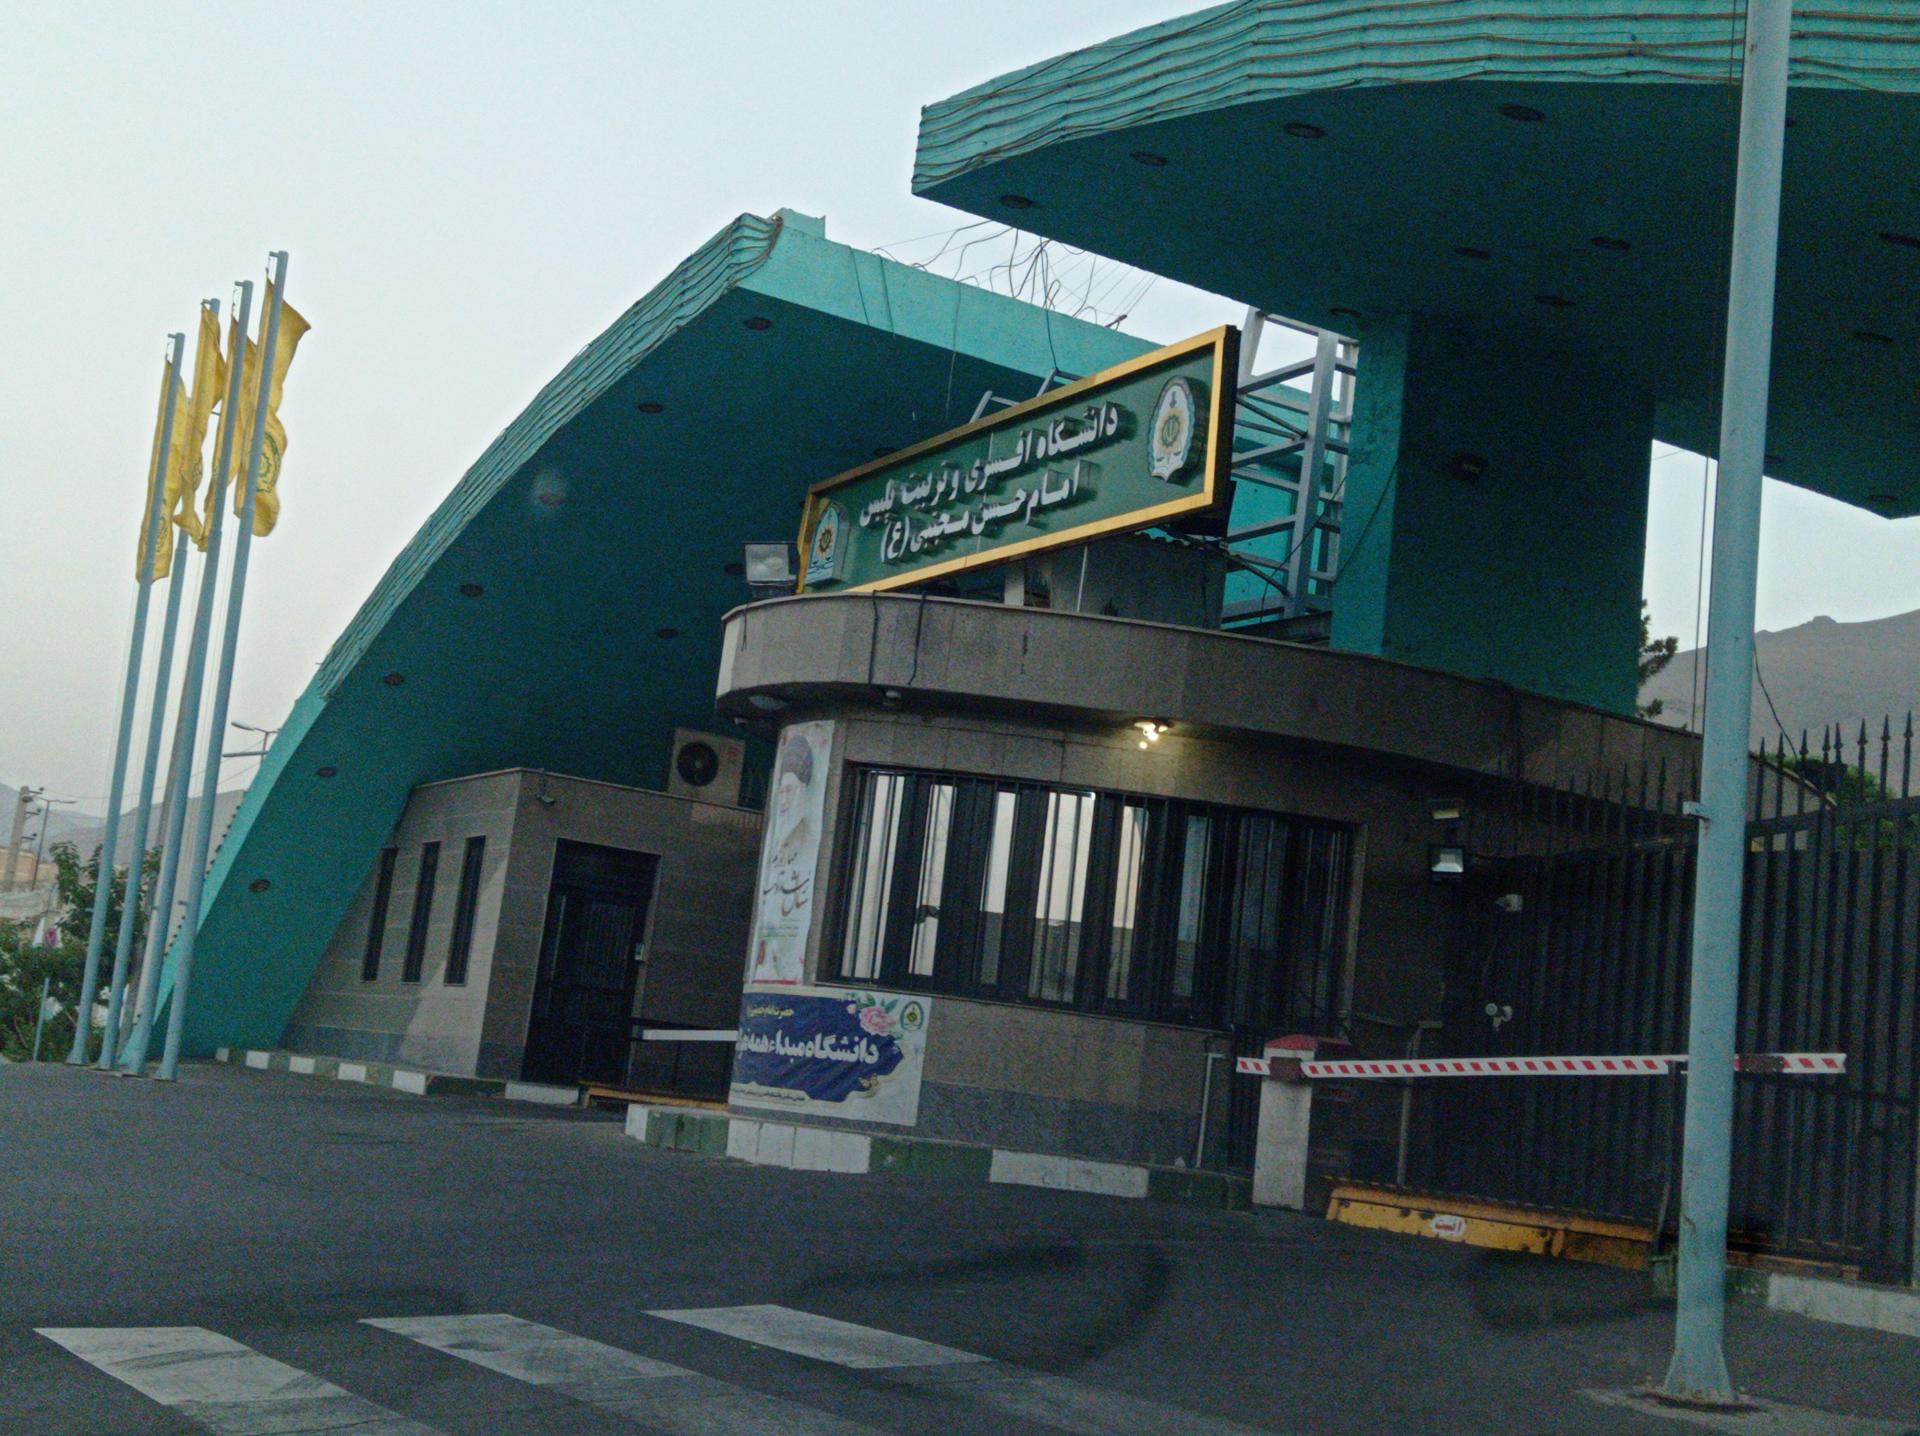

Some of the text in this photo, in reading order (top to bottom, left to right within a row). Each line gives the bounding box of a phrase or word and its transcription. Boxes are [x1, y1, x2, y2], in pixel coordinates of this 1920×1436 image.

[1036, 402, 1119, 460] دانشگاه
[965, 429, 1033, 493] افسری
[971, 488, 1027, 536] حسن
[1025, 457, 1081, 525] امام
[910, 510, 970, 553] مجتبی
[805, 1031, 880, 1064] دانشگاه
